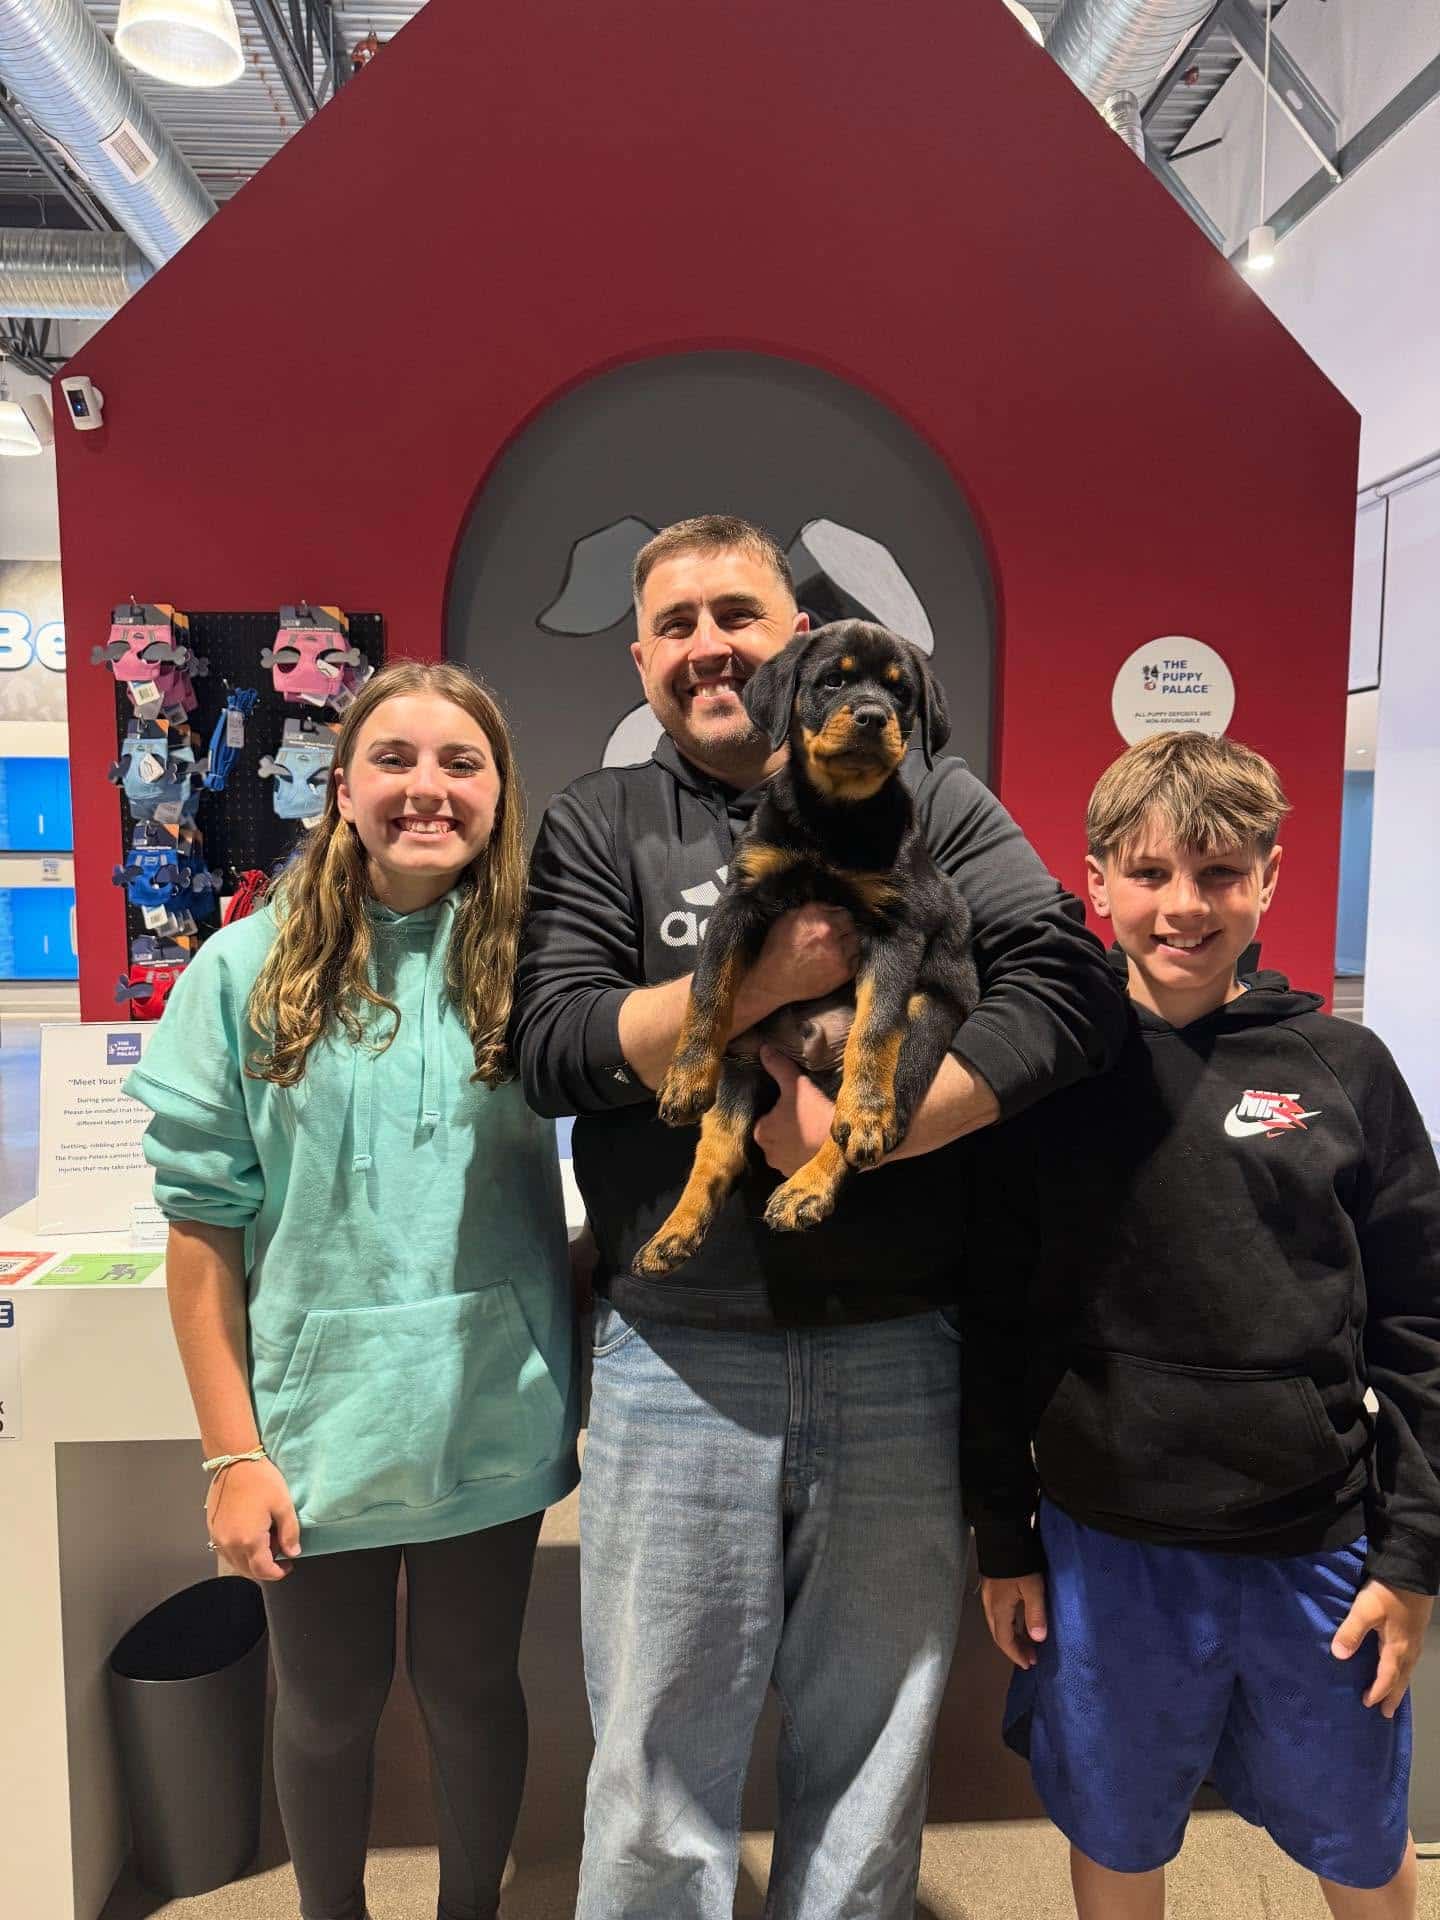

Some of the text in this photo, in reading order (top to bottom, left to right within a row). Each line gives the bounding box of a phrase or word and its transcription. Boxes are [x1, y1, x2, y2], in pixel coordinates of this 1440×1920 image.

[1163, 659, 1188, 669] THE
[1162, 671, 1203, 681] PUPPY
[1162, 685, 1209, 694] PALACE
